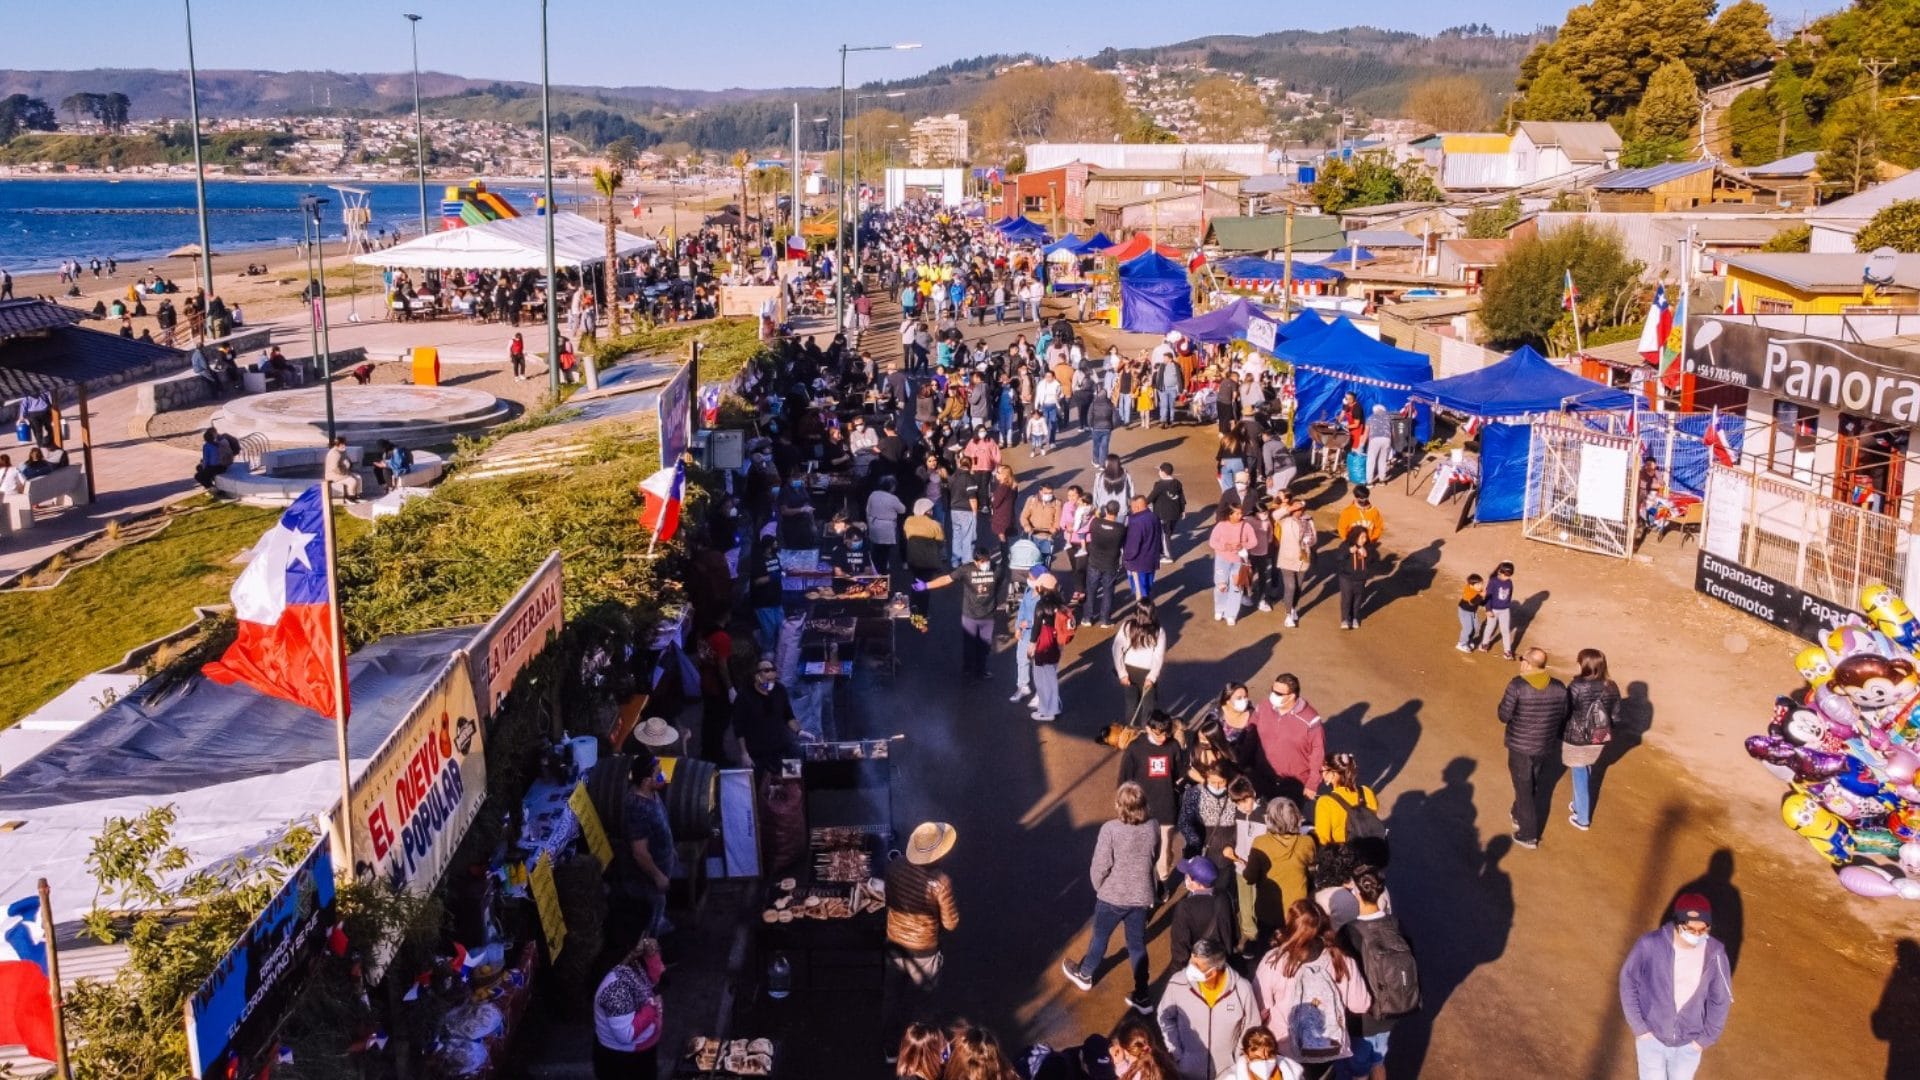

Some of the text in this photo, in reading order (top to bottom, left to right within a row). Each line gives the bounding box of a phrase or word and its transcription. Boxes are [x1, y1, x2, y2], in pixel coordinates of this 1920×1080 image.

[1762, 343, 1920, 423] Panora
[503, 582, 557, 663] VETERANA
[1703, 555, 1775, 597] Empanadas
[1802, 595, 1848, 625] Papas
[1704, 577, 1775, 622] Terremotos
[368, 730, 439, 862] EL NUEVO
[401, 758, 464, 875] POPULAR
[228, 1022, 241, 1039] EL
